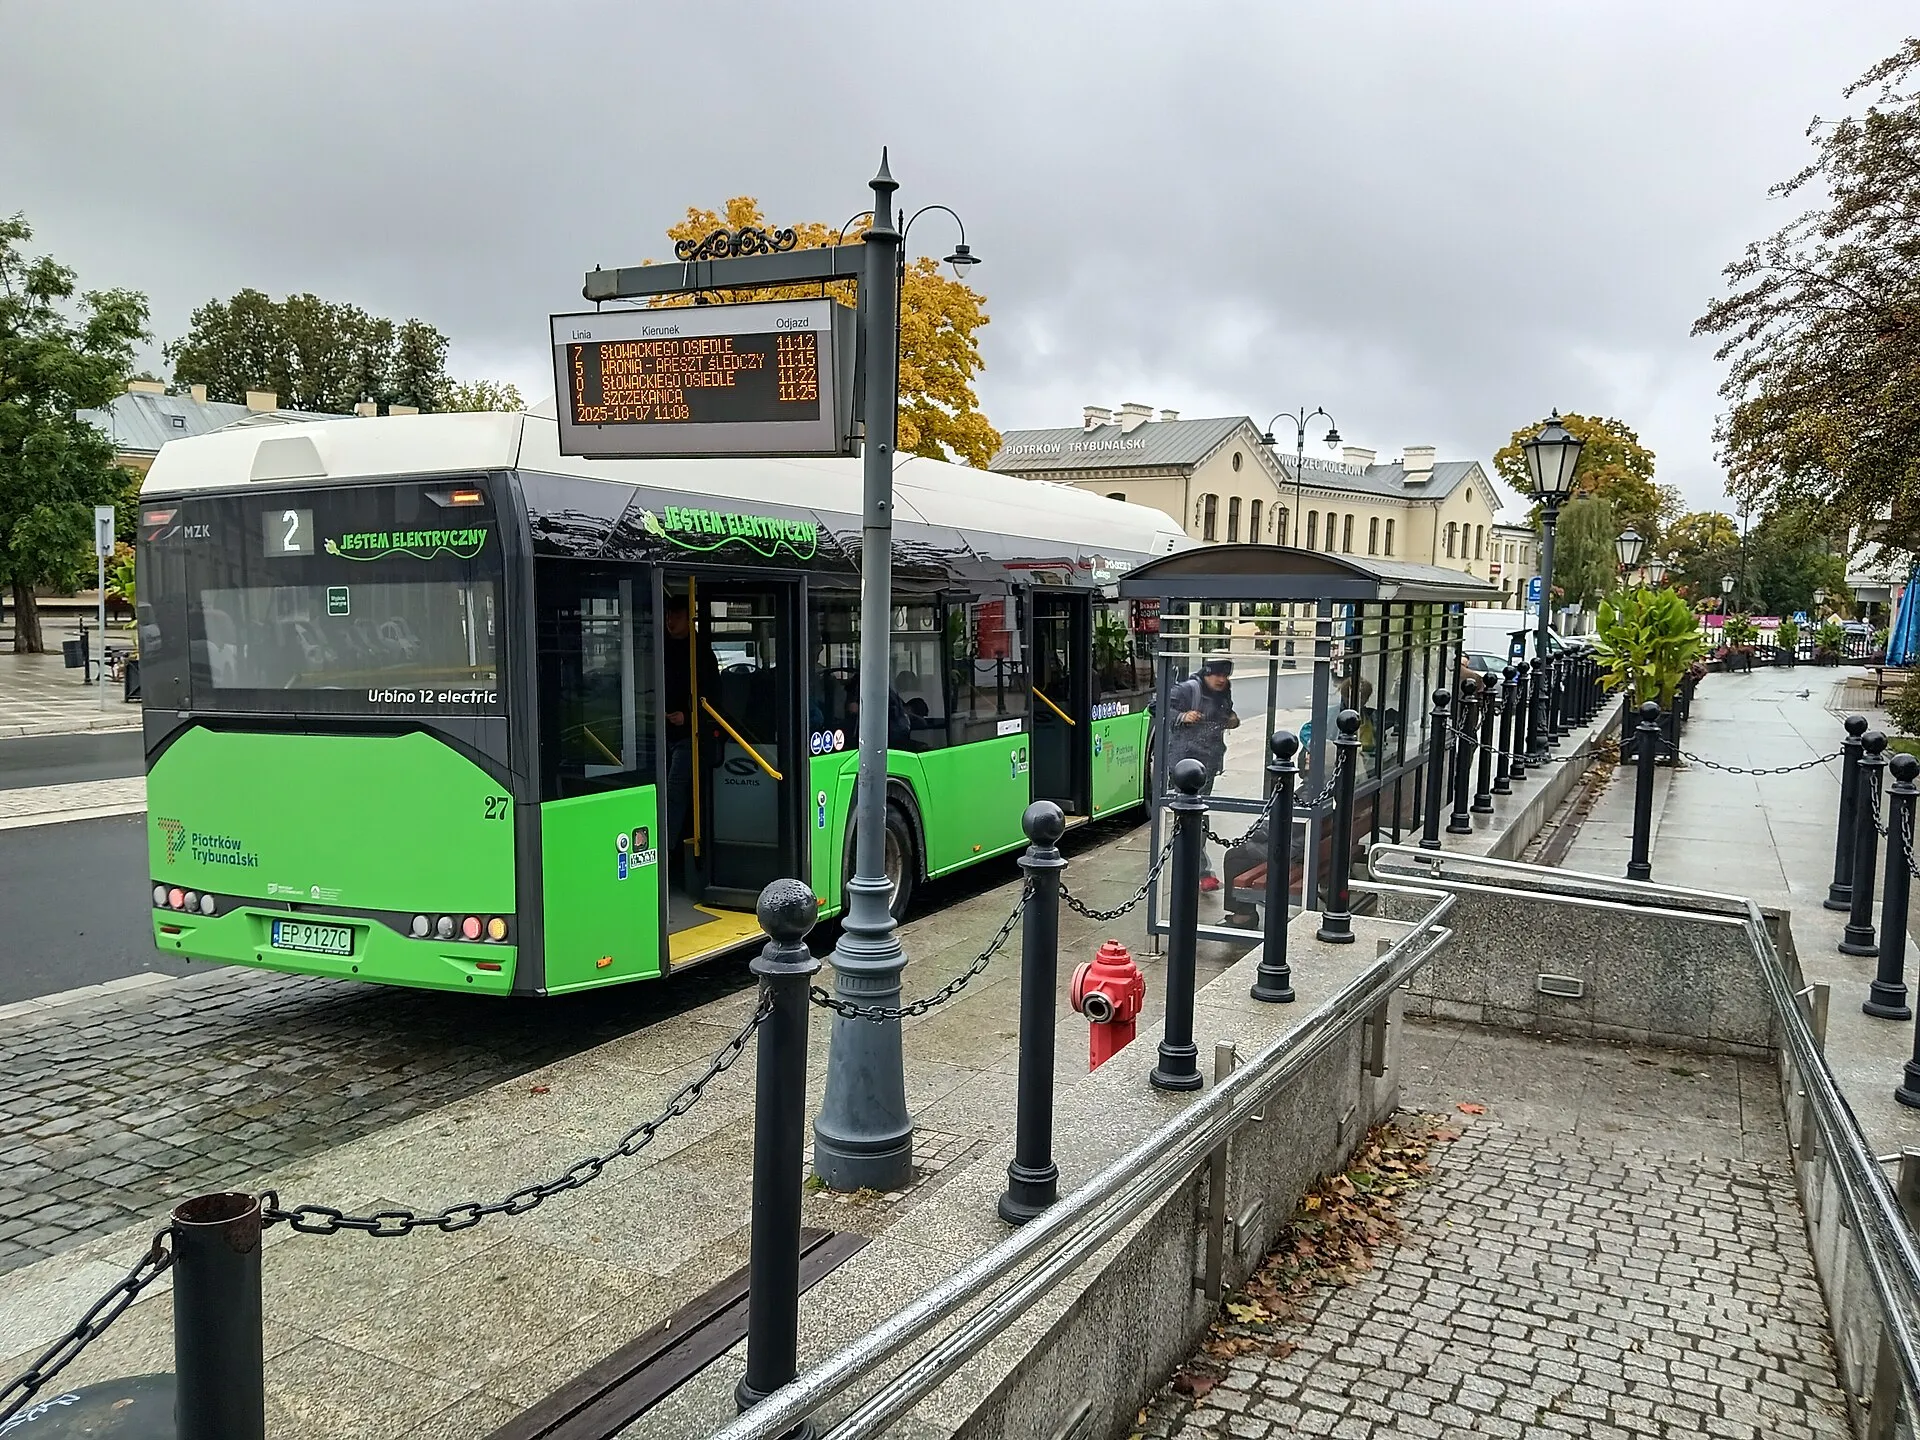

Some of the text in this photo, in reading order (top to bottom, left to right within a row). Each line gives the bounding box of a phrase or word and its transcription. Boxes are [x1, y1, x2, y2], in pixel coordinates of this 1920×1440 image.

[642, 325, 680, 336] Kierunek
[776, 317, 809, 330] Odjazd
[572, 330, 592, 340] Linia
[574, 334, 815, 361] 7 SŁOWACKIEGO OSIEDLE 11:12
[575, 361, 584, 376] 5
[601, 359, 642, 374] WRONIA
[656, 356, 703, 372] ARESZT
[778, 351, 816, 367] 11:15
[602, 373, 680, 390] SŁOWACKIEGO
[684, 371, 735, 387] OSIEDLE
[779, 368, 817, 384] 11:22
[577, 384, 818, 407] 1 SZCZEKANICA 11:25
[578, 404, 690, 422] 2025-10-07 11:08
[1006, 438, 1145, 454] PIOTRKÓW TRYBUNALSKI
[1322, 460, 1367, 477] KOLEJOWY
[184, 525, 211, 539] MZK
[282, 509, 301, 552] 2
[664, 506, 817, 542] JESTEM ELEKTRYCZNY
[340, 528, 488, 551] JESTEM ELEKTRYCZNY
[367, 689, 498, 705] Urbino 12 electric
[724, 778, 760, 786] SOLARIS
[484, 796, 509, 820] 27
[191, 832, 242, 851] Piotrków
[191, 847, 259, 868] Trybunalski
[281, 924, 300, 943] EP
[303, 926, 348, 949] 9127C
